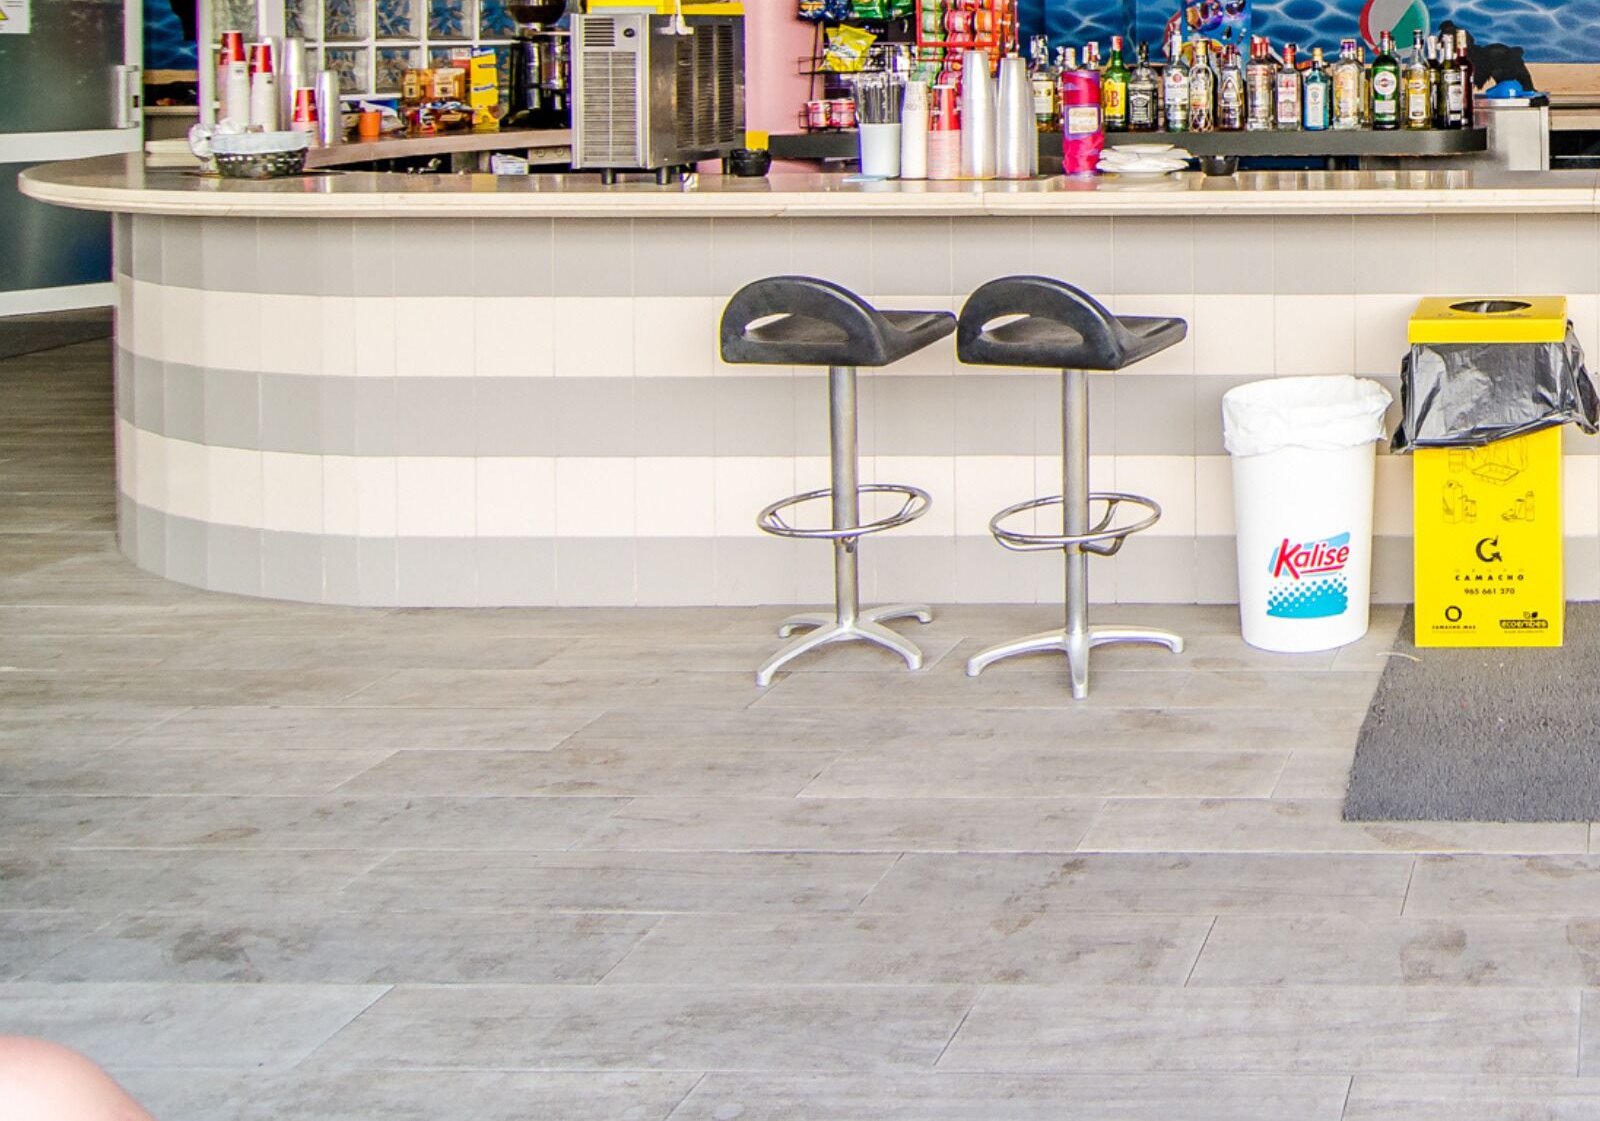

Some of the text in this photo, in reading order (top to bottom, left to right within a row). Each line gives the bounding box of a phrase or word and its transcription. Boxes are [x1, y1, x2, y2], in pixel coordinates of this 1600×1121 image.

[1273, 538, 1350, 580] Kalise
[1455, 574, 1524, 582] CAMACHO
[1464, 587, 1479, 596] 965
[1481, 587, 1497, 596] 661
